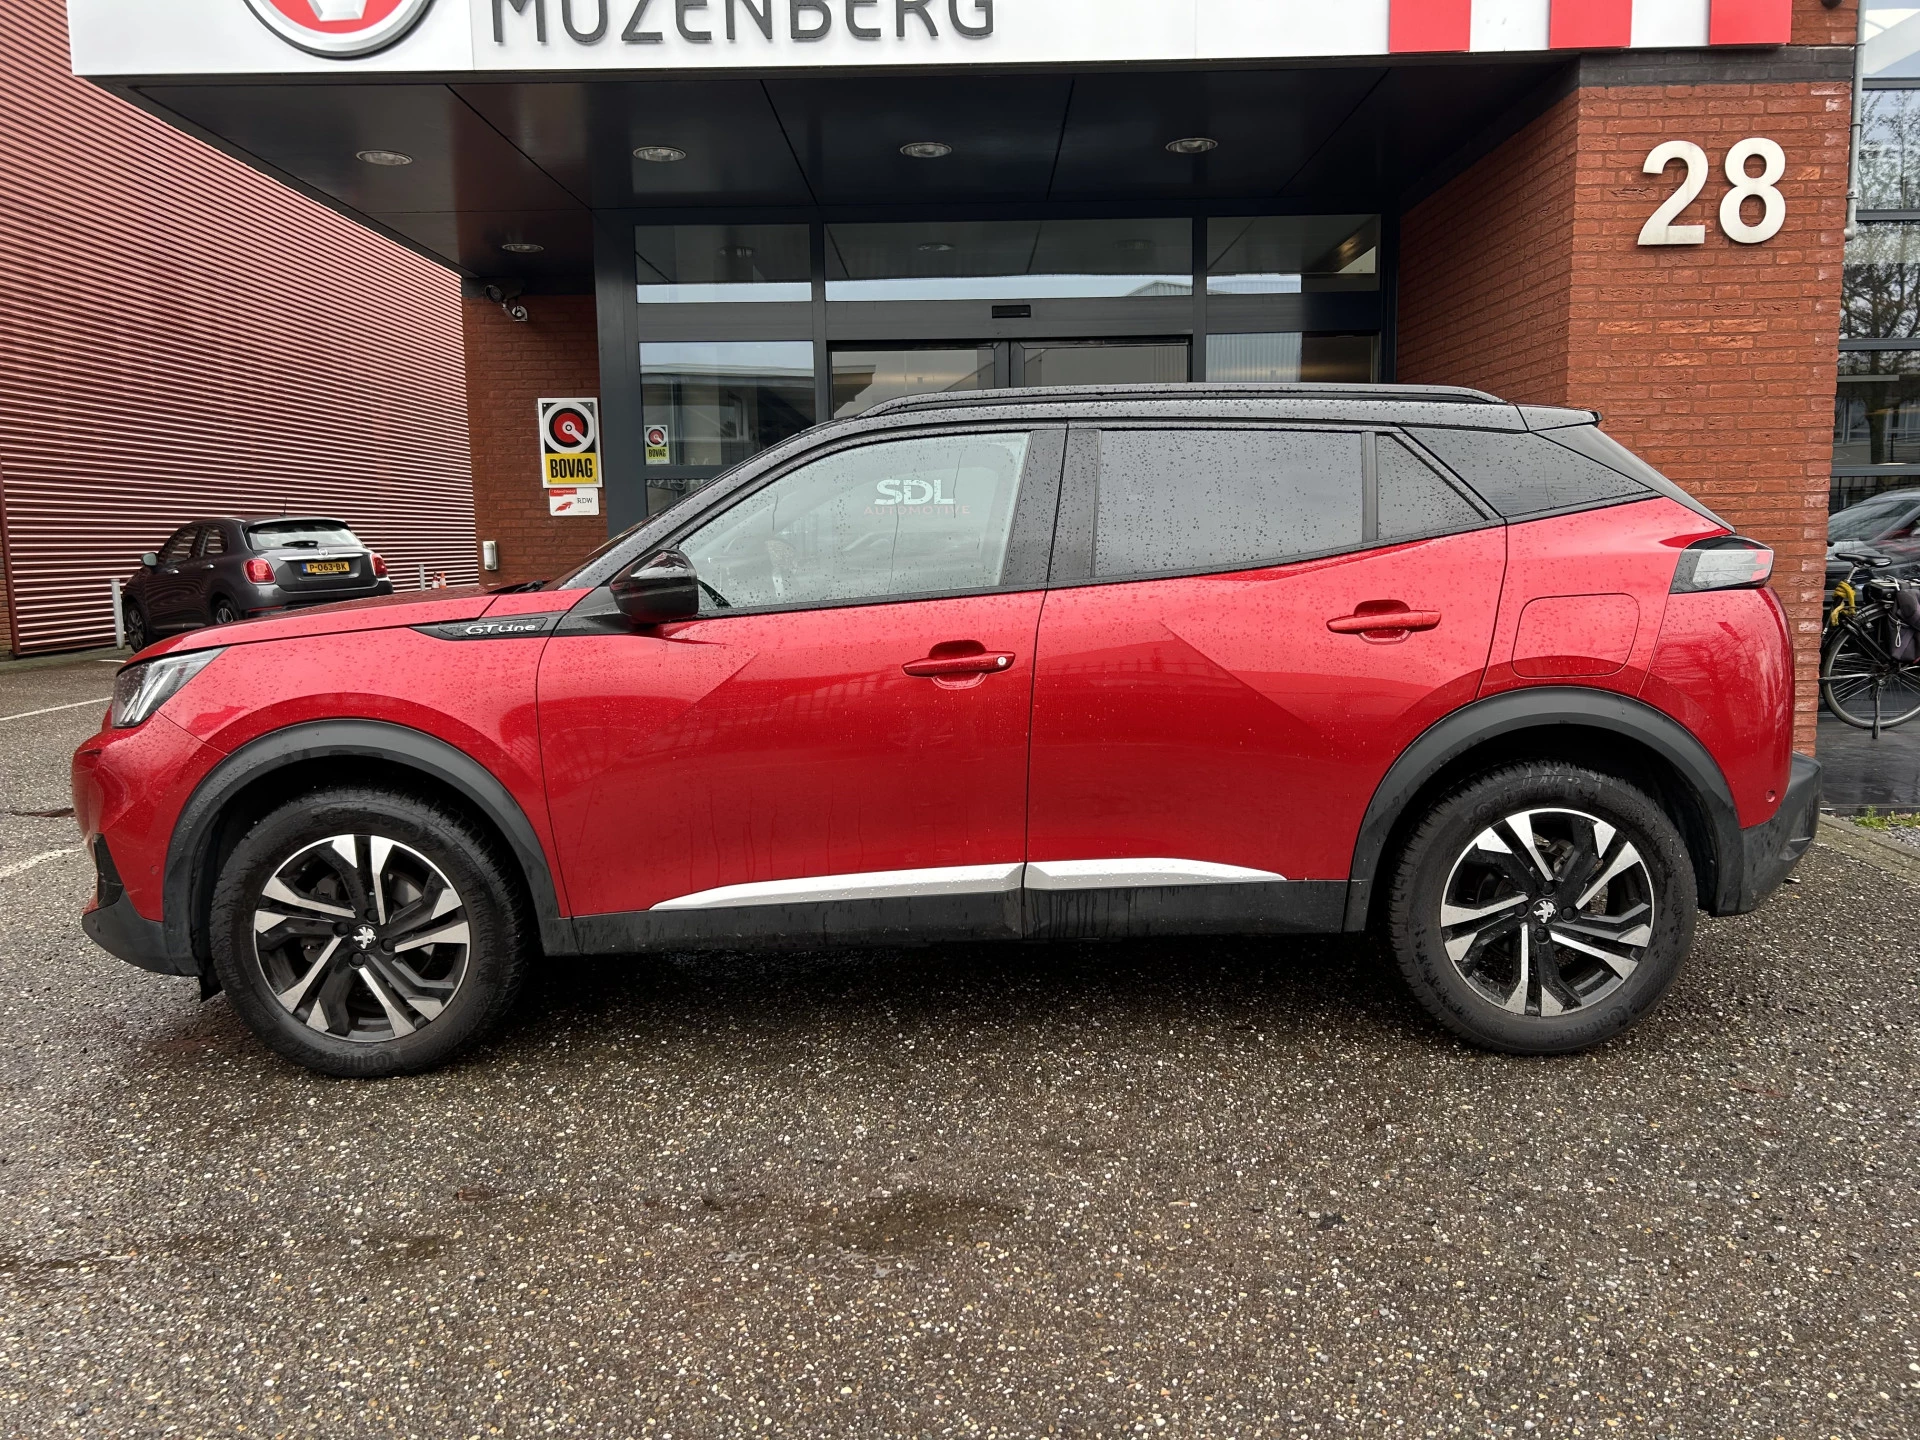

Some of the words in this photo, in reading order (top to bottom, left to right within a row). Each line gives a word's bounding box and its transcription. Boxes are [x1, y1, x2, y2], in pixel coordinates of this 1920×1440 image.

[1638, 137, 1786, 245] 28
[649, 449, 666, 457] BOVAG
[550, 458, 593, 478] BOVAG
[875, 479, 954, 505] SDL
[864, 505, 970, 515] AUTOMOTIVE
[309, 563, 347, 572] P-063-BK
